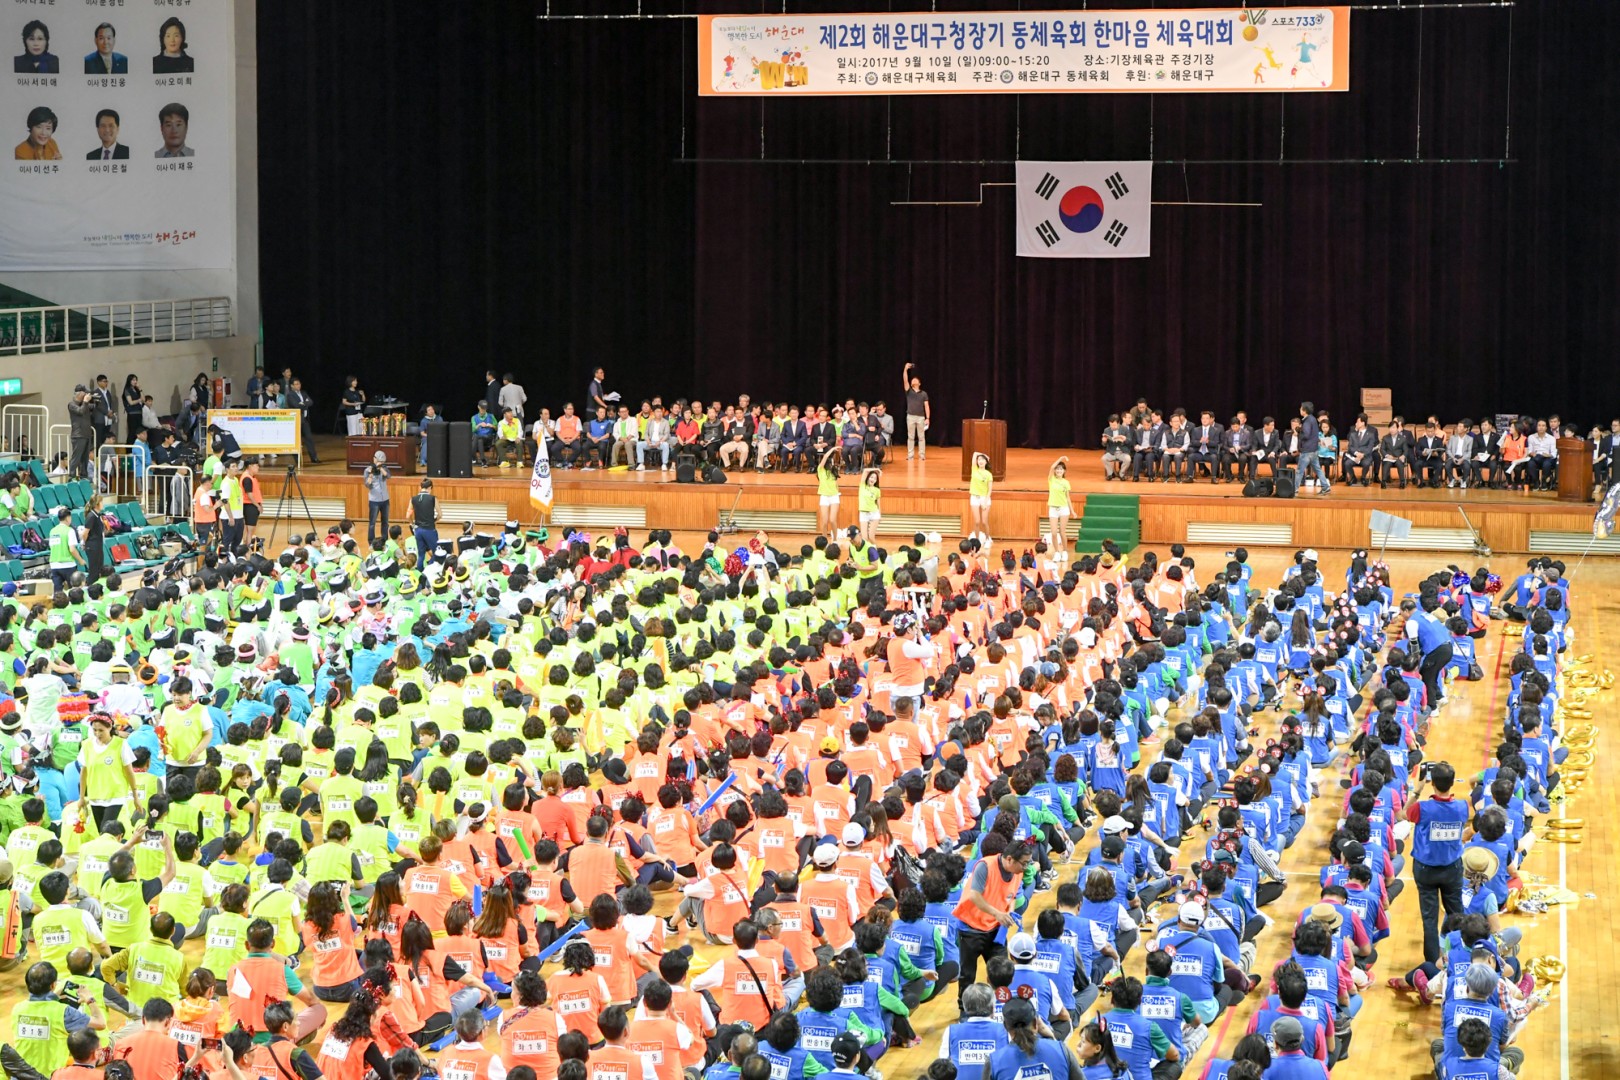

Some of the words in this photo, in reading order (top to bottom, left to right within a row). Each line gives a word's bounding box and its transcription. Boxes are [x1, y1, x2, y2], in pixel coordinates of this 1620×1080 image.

[727, 32, 747, 41] 행복한
[749, 32, 763, 41] 도시
[765, 24, 805, 41] 해운대
[820, 23, 866, 50] 제2회
[872, 20, 1004, 51] 해운대구청장기
[1011, 20, 1086, 50] 동체육회
[1093, 19, 1150, 49] 한마음
[1156, 18, 1233, 48] 체육대회
[836, 56, 898, 69] 일시:2017년
[904, 55, 922, 68] 9월
[928, 55, 952, 68] 10일
[957, 54, 1050, 68] (일)09:00~15:20
[1083, 53, 1165, 67] 장소:기장체육관
[1170, 53, 1215, 66] 주경기장
[836, 72, 862, 85] 주최:
[881, 71, 957, 84] 해운대구체육회
[972, 70, 997, 83] 주관:
[1017, 70, 1061, 82] 해운대구
[1066, 69, 1109, 83] 동체육회
[1125, 69, 1151, 82] 후원:
[1170, 69, 1215, 82] 해운대구
[17, 78, 30, 87] 이사
[87, 79, 99, 88] 이사
[155, 78, 167, 87] 이사
[19, 165, 31, 174] 이사
[33, 164, 59, 174] 이선주
[89, 165, 101, 174] 이사
[156, 163, 168, 172] 이사
[155, 229, 196, 245] 해운대
[1175, 964, 1197, 972] 송정동
[564, 1001, 587, 1010] 좌1동
[1146, 1007, 1170, 1015] 송정동
[518, 1042, 542, 1051] 좌1동
[806, 1039, 831, 1048] 반송1동
